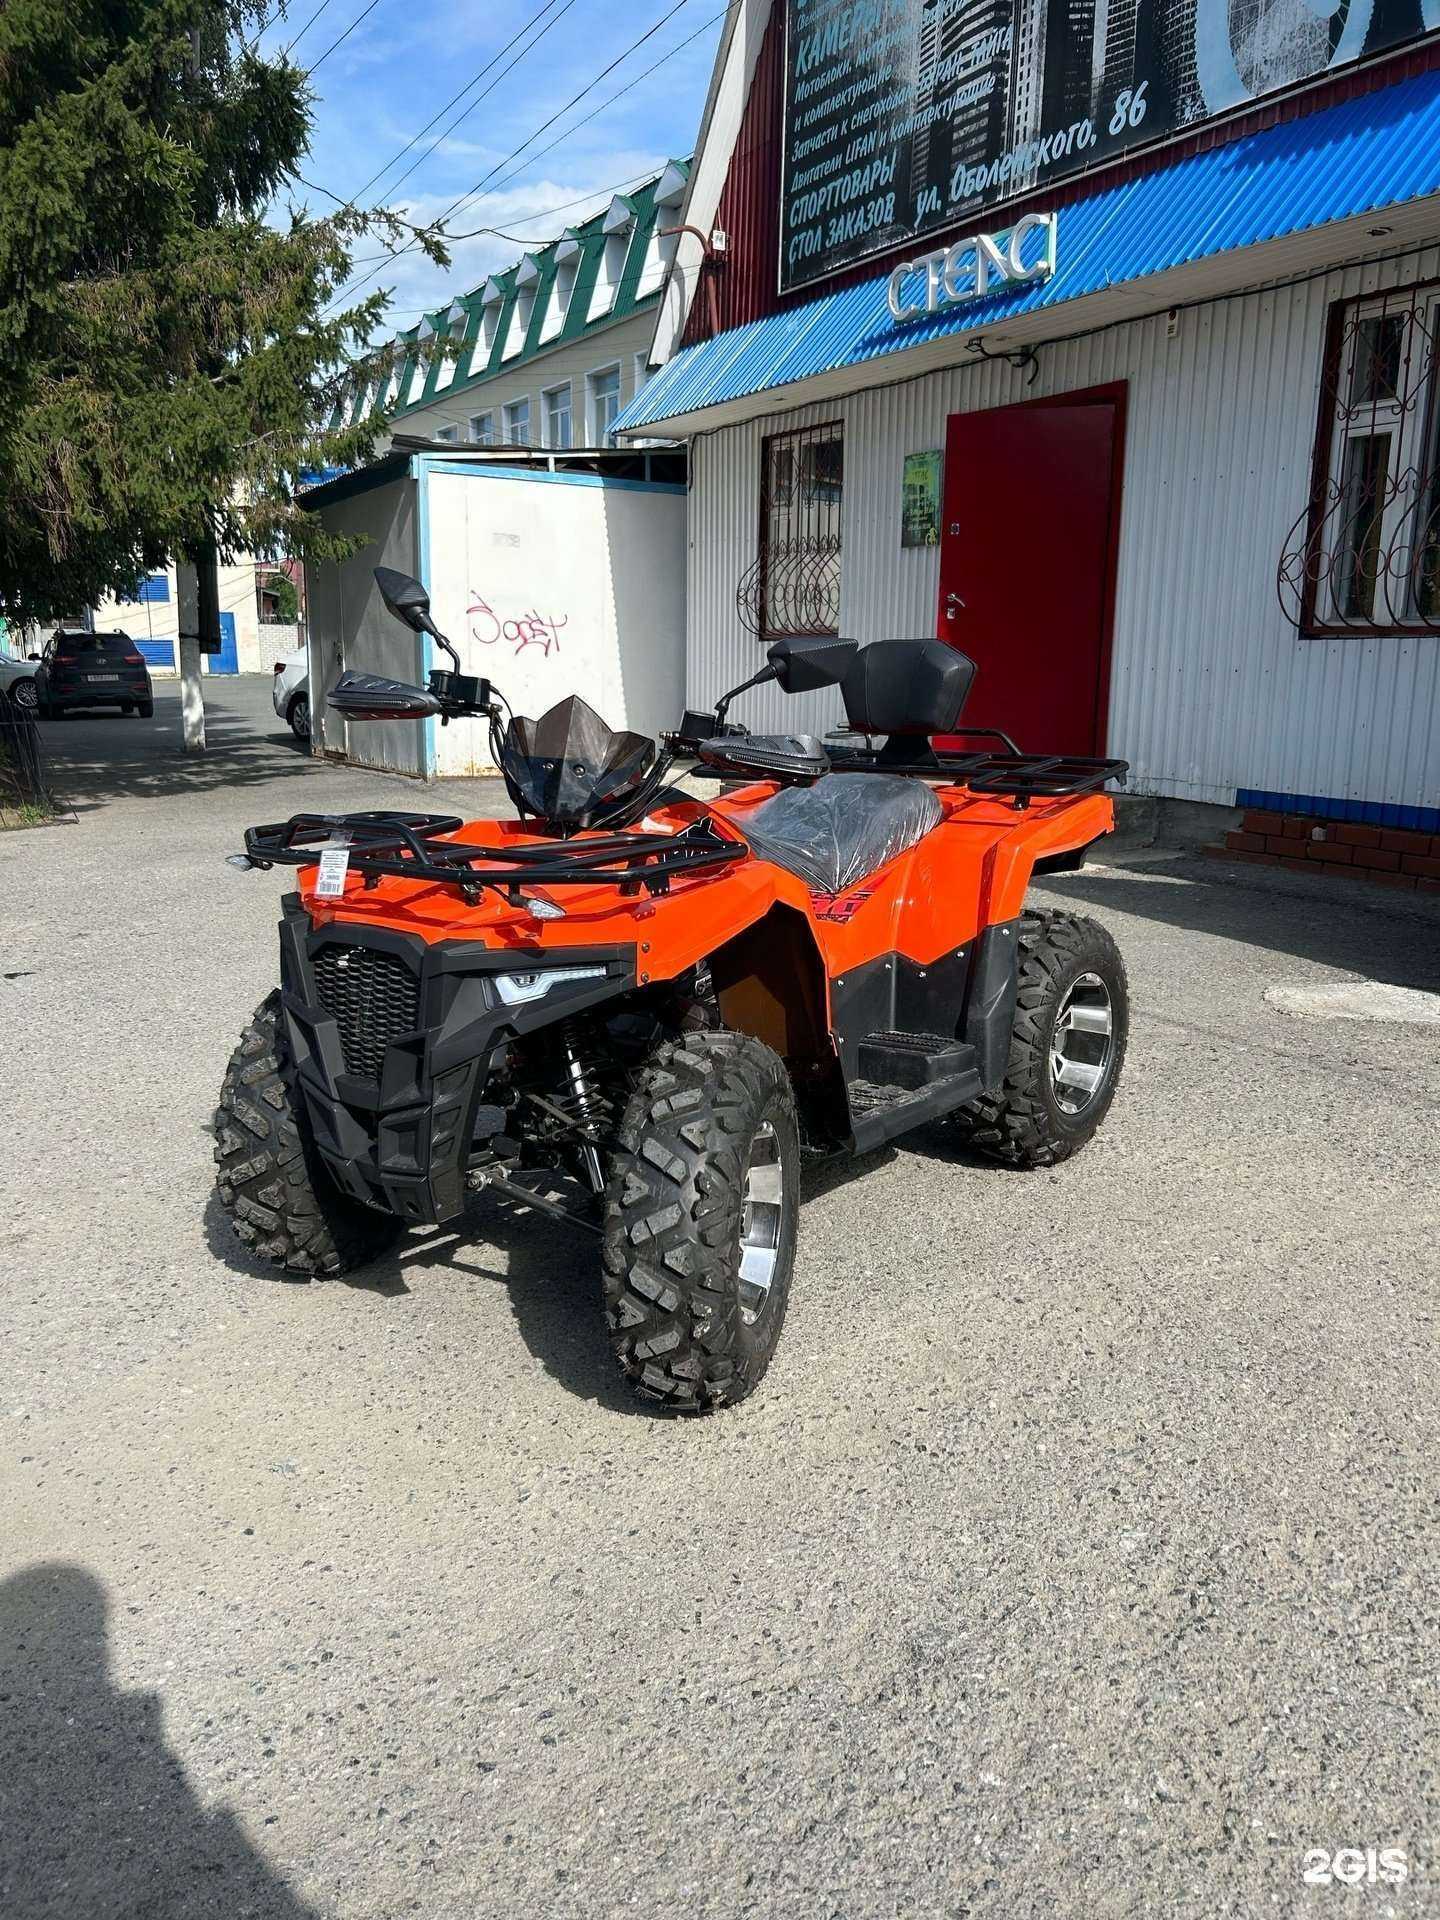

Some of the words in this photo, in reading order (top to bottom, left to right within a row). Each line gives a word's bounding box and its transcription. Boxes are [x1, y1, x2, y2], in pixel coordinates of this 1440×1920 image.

[790, 154, 843, 193] Двигатели
[845, 130, 878, 165] LIFAN
[879, 130, 888, 147] и
[889, 75, 996, 142] комплектующие
[803, 63, 893, 127] комплектующие
[791, 122, 839, 162] Запчасти
[841, 118, 849, 137] к
[913, 186, 942, 229] ул.
[1108, 80, 1149, 136] 86
[789, 146, 897, 228] СПОРТТОВАРЫ
[788, 225, 823, 265] СТОЛ
[825, 192, 896, 249] ЗАКАЗОВ
[887, 213, 1051, 321] СТЕЛС
